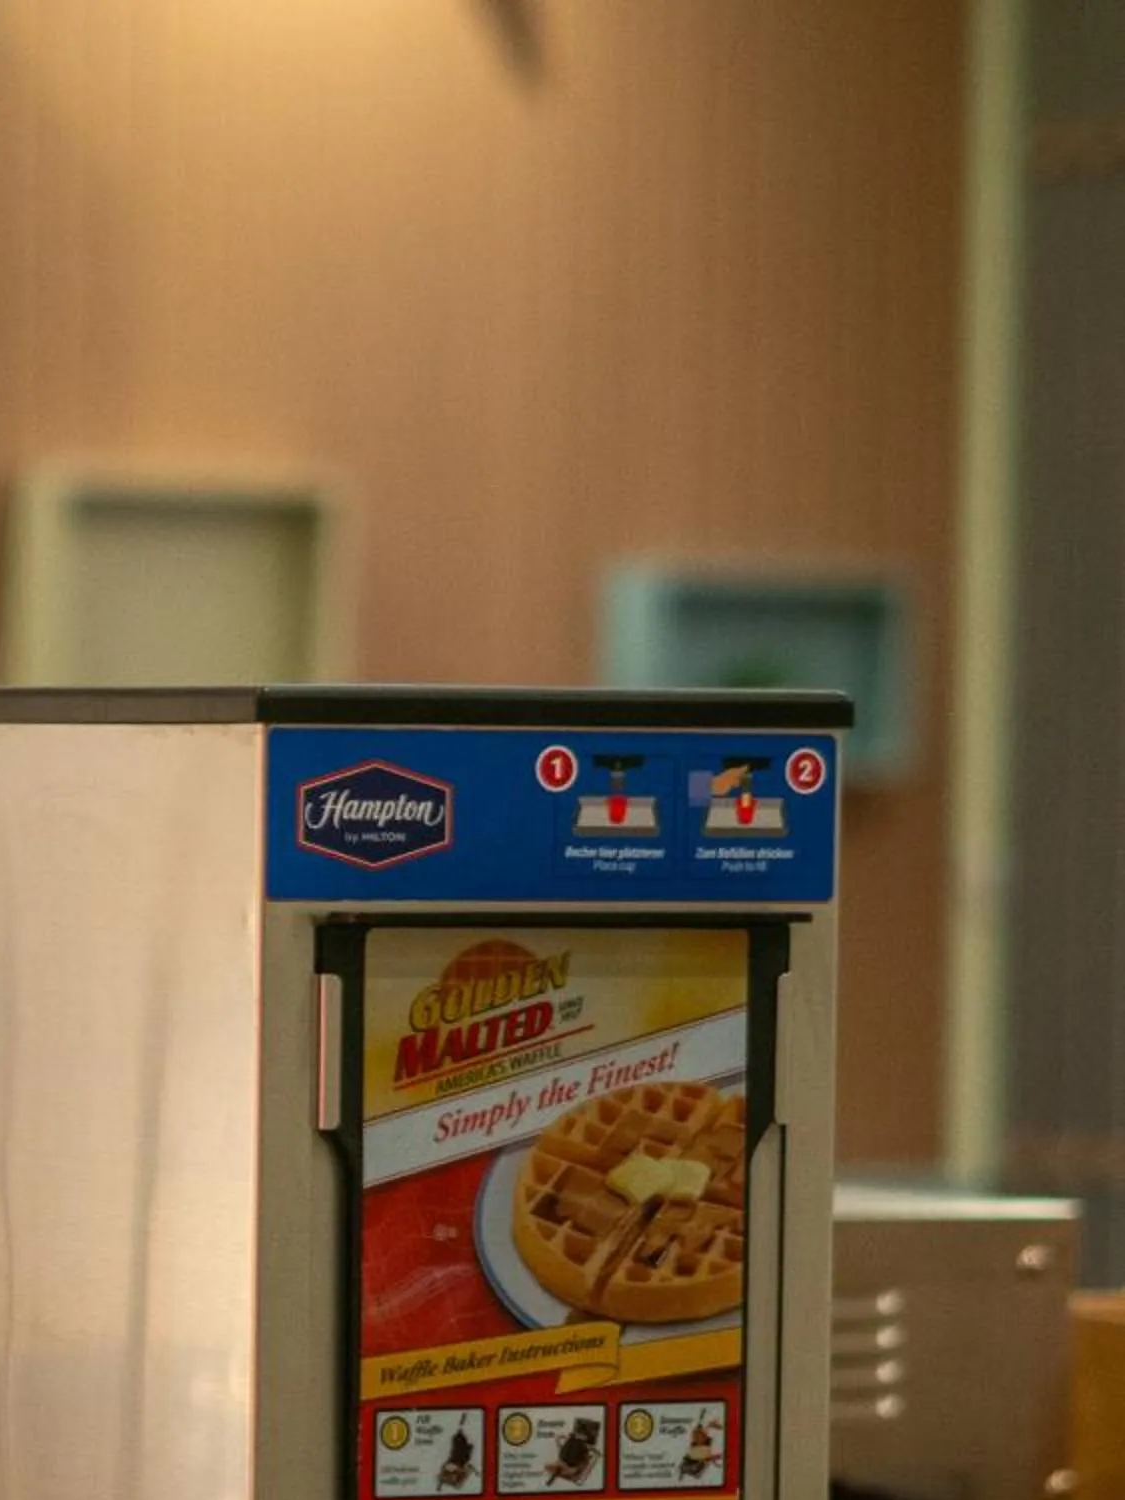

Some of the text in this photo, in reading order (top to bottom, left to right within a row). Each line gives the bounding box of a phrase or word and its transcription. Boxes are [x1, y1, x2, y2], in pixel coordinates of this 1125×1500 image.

[551, 759, 563, 779] 1
[799, 762, 812, 781] 2
[305, 789, 444, 829] Hampton
[362, 832, 406, 842] HILTON
[410, 950, 570, 1033] GOLDEN
[394, 1001, 553, 1083] MALTED
[433, 1042, 680, 1143] Simply the Finest!
[380, 1333, 606, 1386] Waffle Baker Instructions
